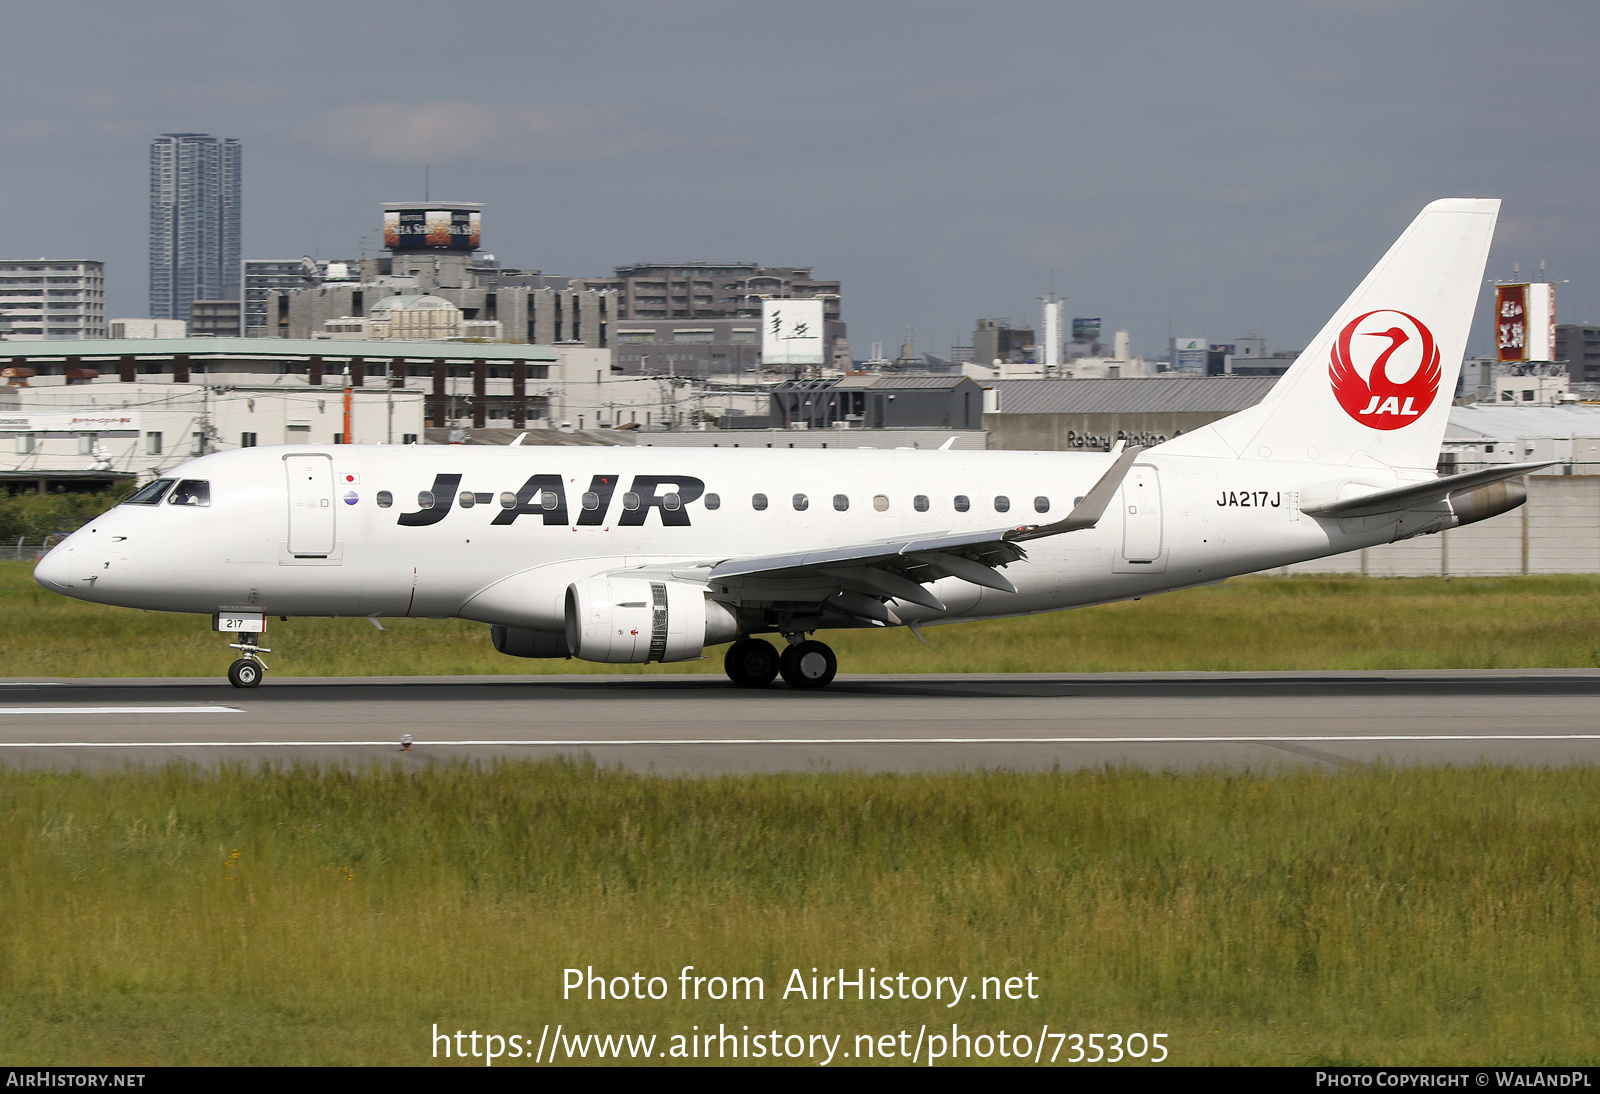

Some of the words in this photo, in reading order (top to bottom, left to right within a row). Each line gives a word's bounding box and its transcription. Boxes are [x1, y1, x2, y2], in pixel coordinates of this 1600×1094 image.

[1359, 395, 1419, 416] JAL
[1068, 430, 1112, 451] Rotary
[397, 473, 706, 527] J-AIR
[1216, 490, 1281, 509] JA217J
[226, 619, 243, 628] 217
